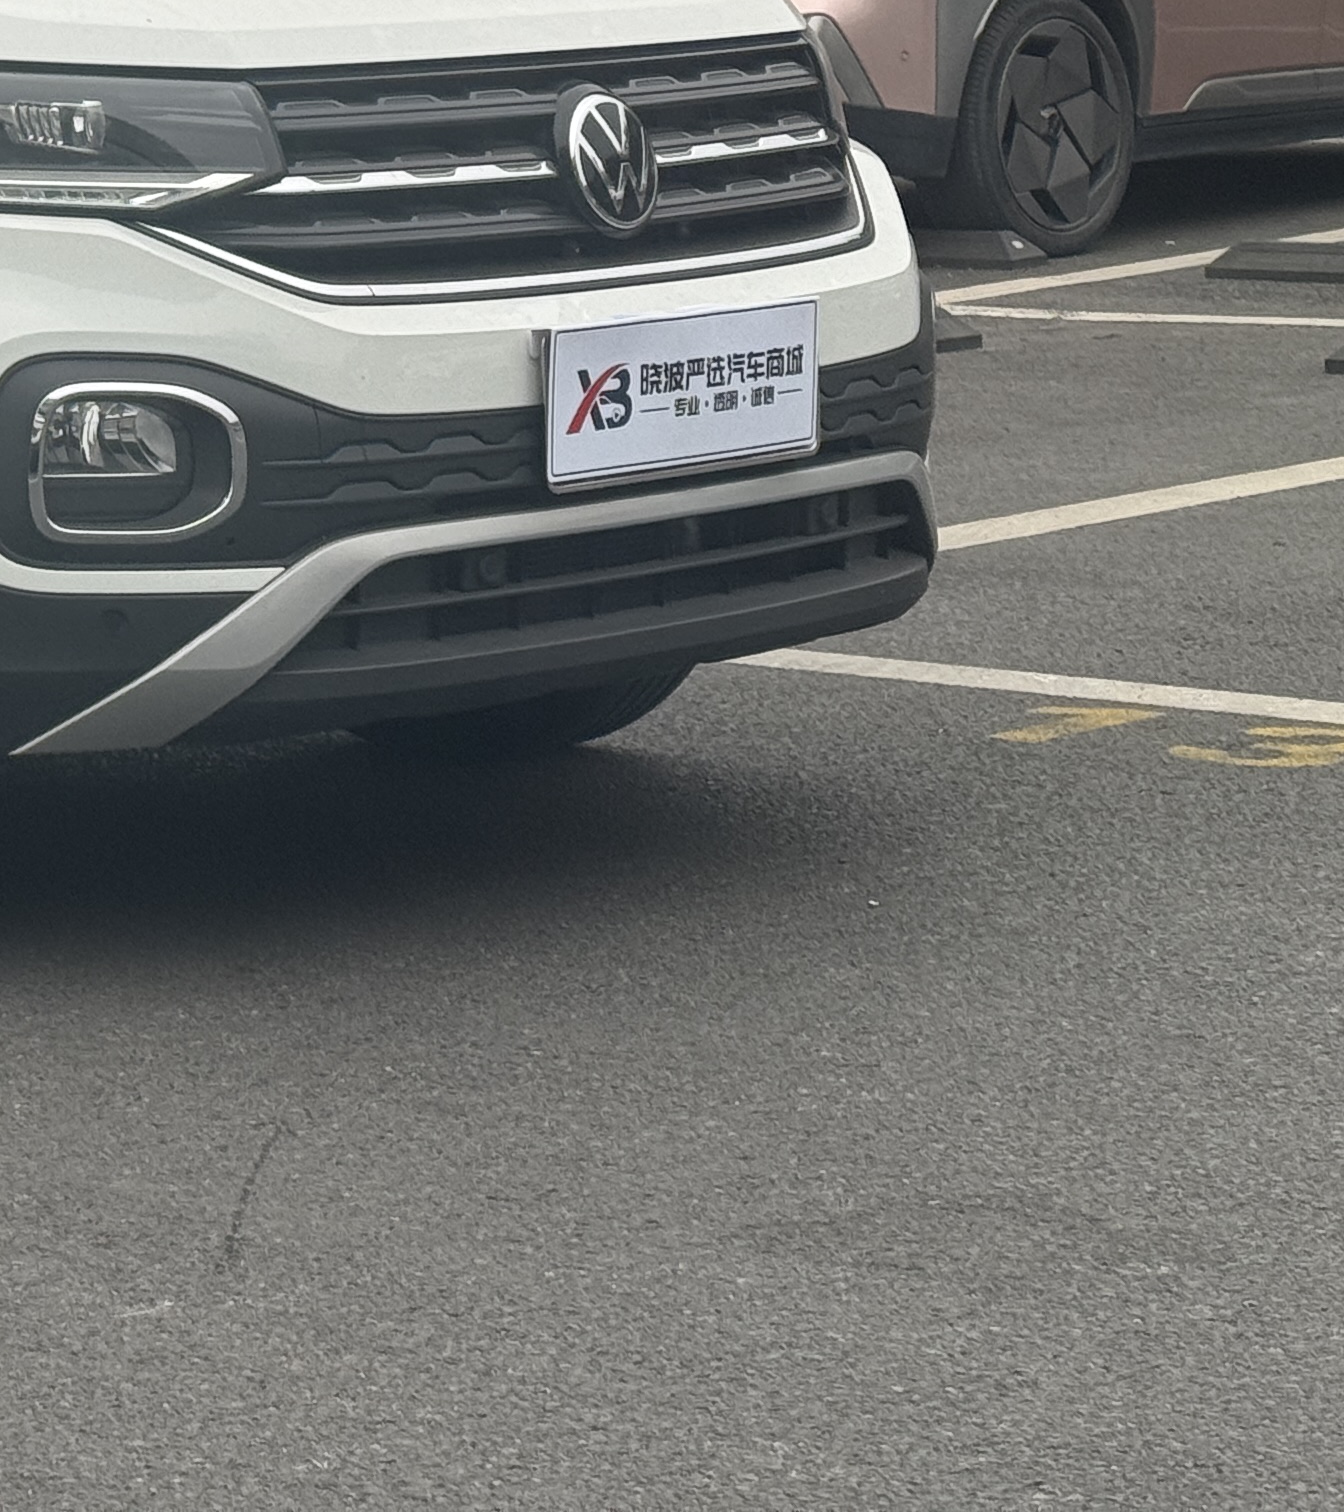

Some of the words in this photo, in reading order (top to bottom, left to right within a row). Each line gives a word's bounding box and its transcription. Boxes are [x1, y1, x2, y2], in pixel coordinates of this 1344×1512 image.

[639, 343, 805, 396] 晓波严选汽车商城
